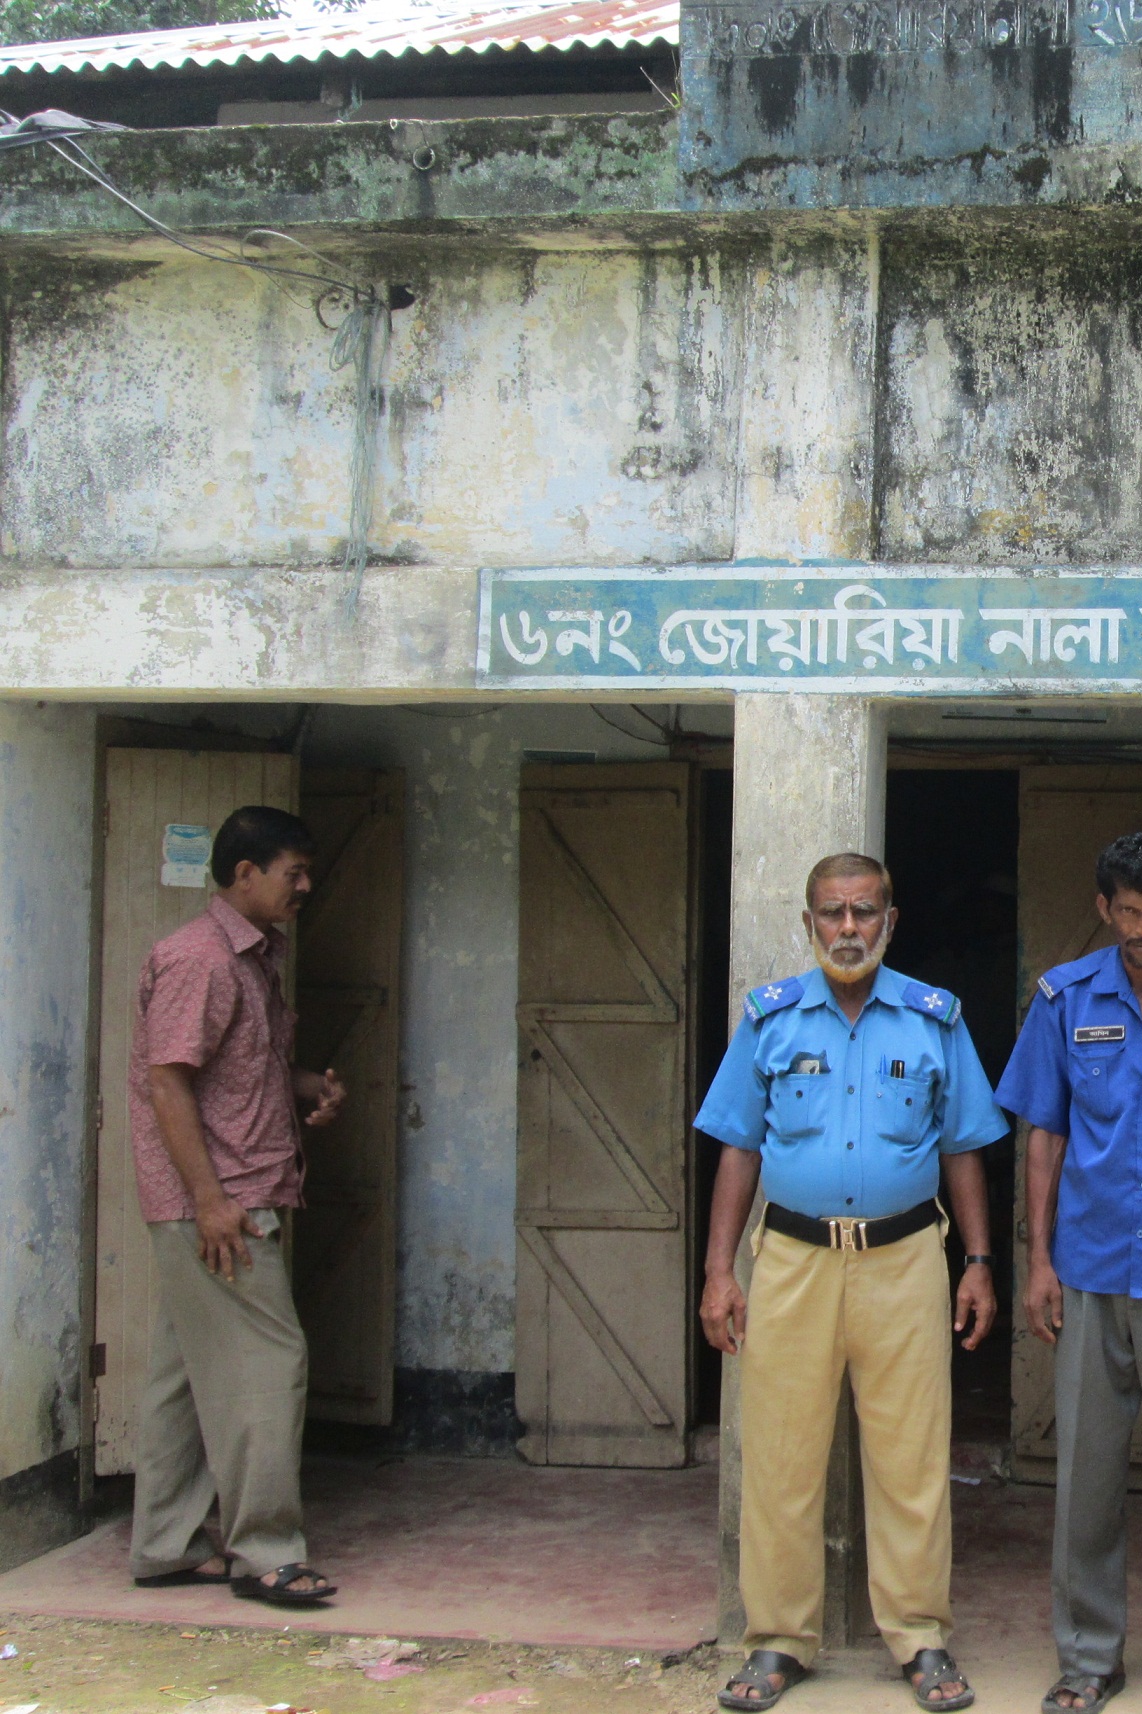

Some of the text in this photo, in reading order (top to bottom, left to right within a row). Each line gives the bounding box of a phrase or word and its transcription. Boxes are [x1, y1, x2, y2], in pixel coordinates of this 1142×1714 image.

[499, 609, 641, 672] ৬নং
[659, 584, 965, 672] জোয়ারিয়া
[980, 607, 1127, 666] নালা
